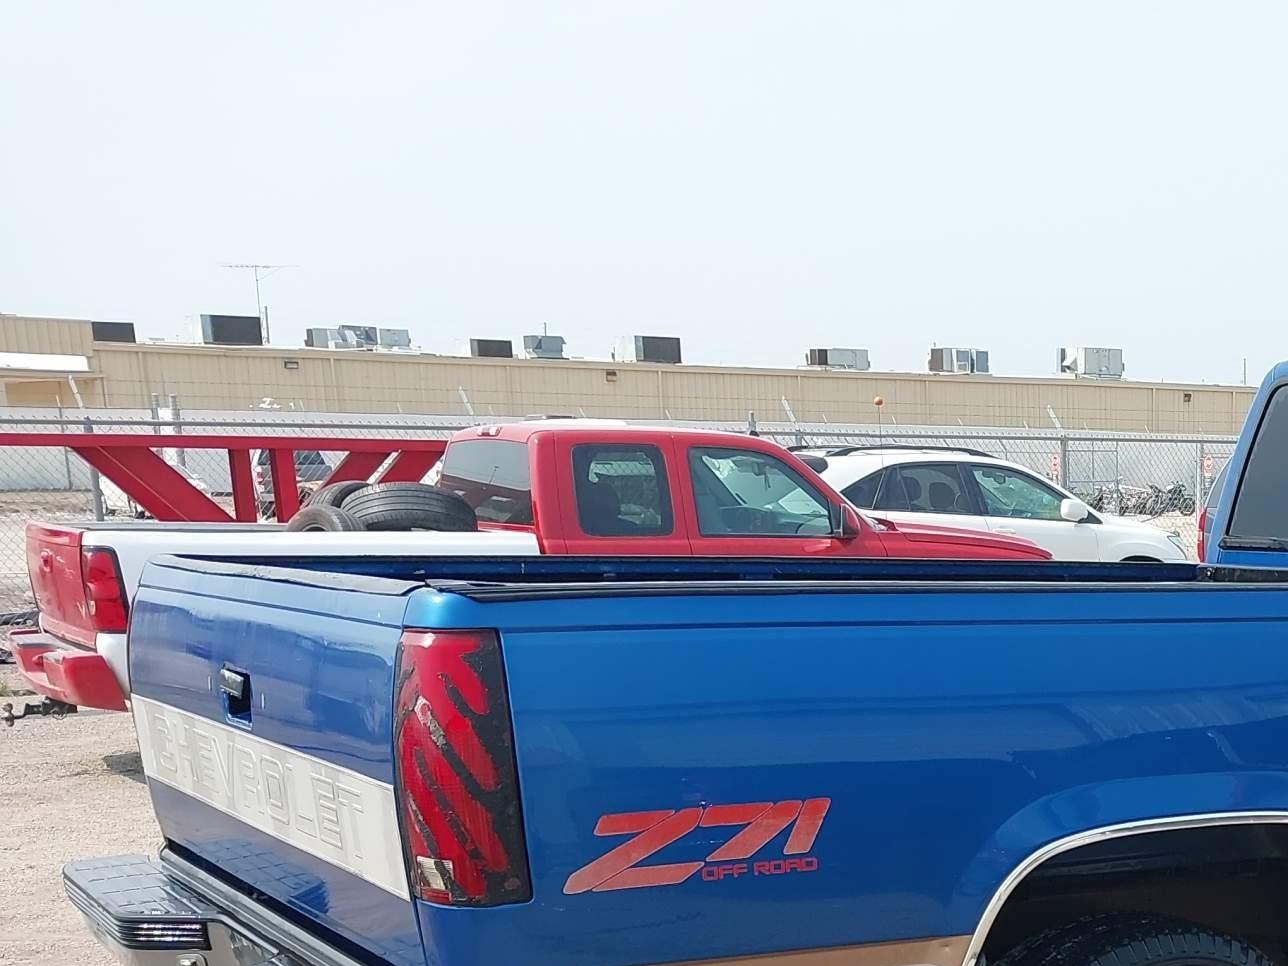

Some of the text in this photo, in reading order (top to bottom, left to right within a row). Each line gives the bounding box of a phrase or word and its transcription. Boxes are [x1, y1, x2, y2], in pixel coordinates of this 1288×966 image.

[152, 713, 364, 859] CHEVROLET
[563, 798, 831, 894] Z71
[702, 857, 818, 881] OFF ROAD
